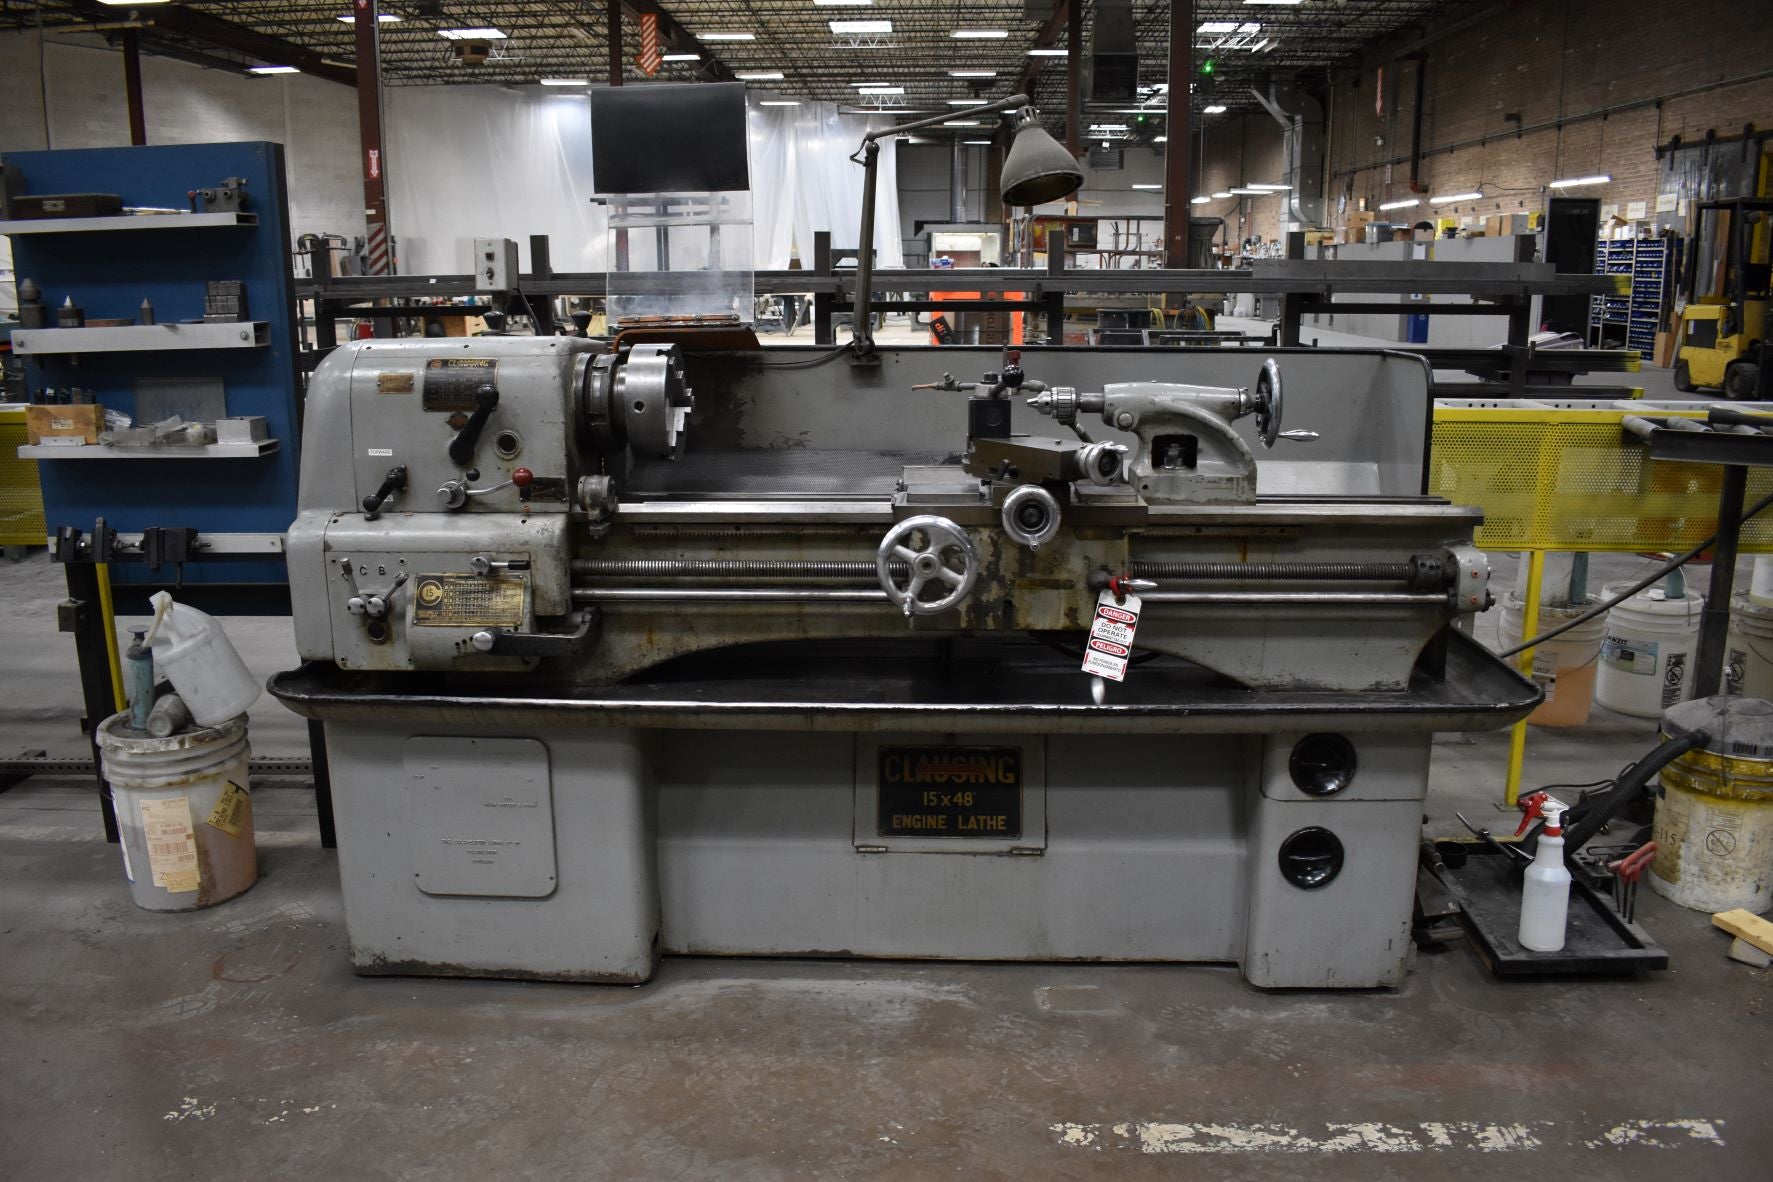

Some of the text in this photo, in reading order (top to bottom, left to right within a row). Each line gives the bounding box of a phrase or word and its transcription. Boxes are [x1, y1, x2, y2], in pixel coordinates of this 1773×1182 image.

[360, 566, 367, 576] C
[1103, 608, 1131, 620] DANGER
[1098, 627, 1128, 640] OPERATE
[1112, 625, 1128, 634] NOT
[1096, 641, 1122, 654] PELIGRO
[884, 754, 1016, 784] CLAUSING
[892, 814, 1007, 831] ENGINE LATHE
